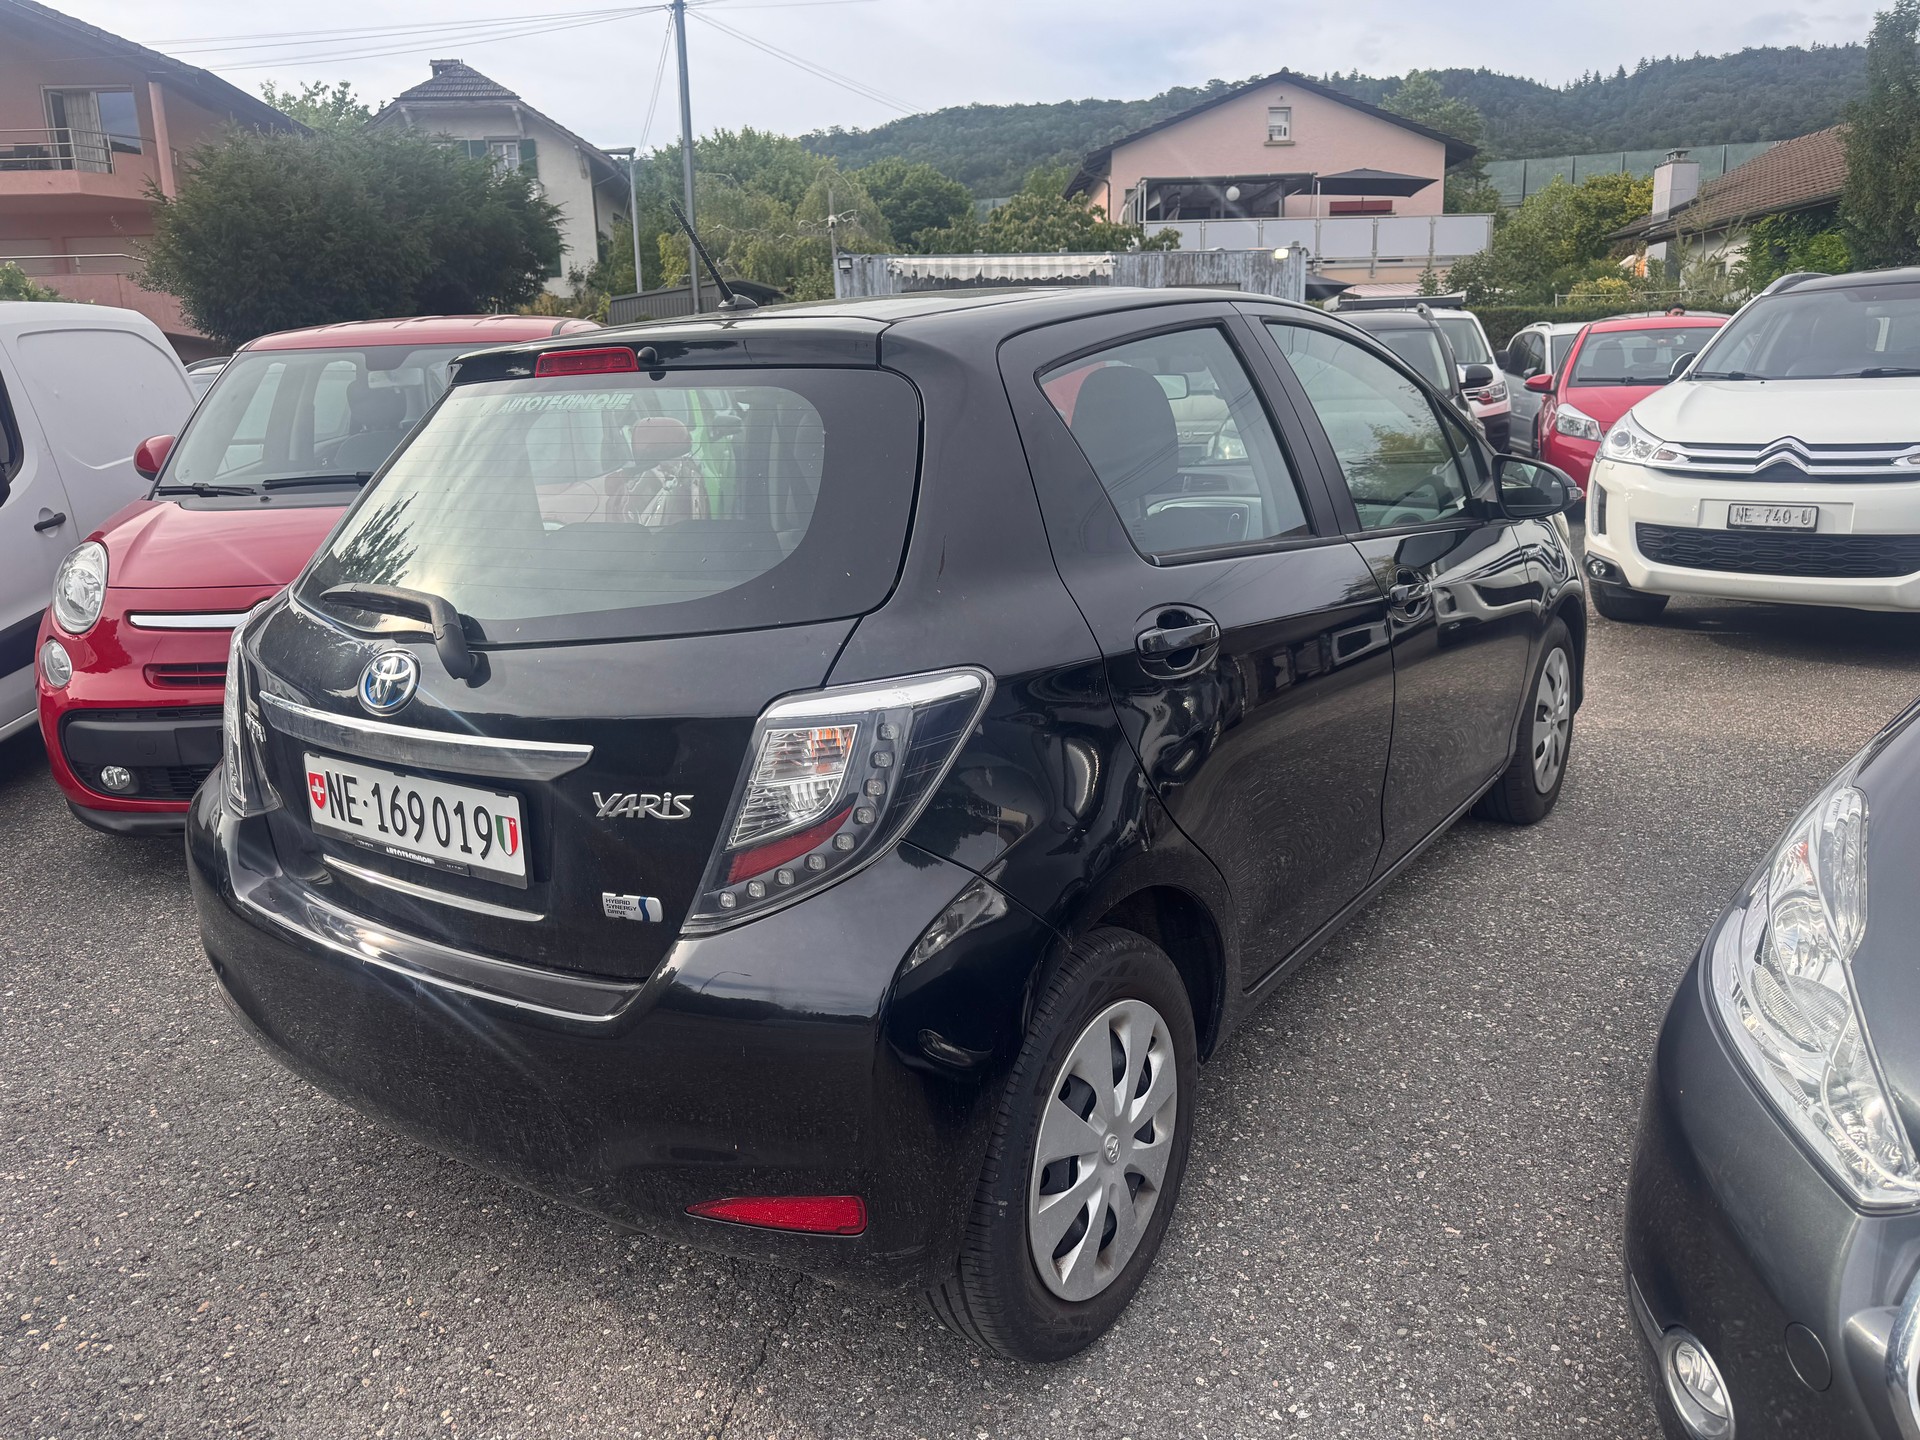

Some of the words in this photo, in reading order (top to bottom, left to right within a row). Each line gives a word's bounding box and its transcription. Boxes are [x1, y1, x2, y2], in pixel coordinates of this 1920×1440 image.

[605, 898, 631, 906] HYBRID
[606, 903, 637, 912] SYNERGY
[607, 908, 627, 916] DRIVE
